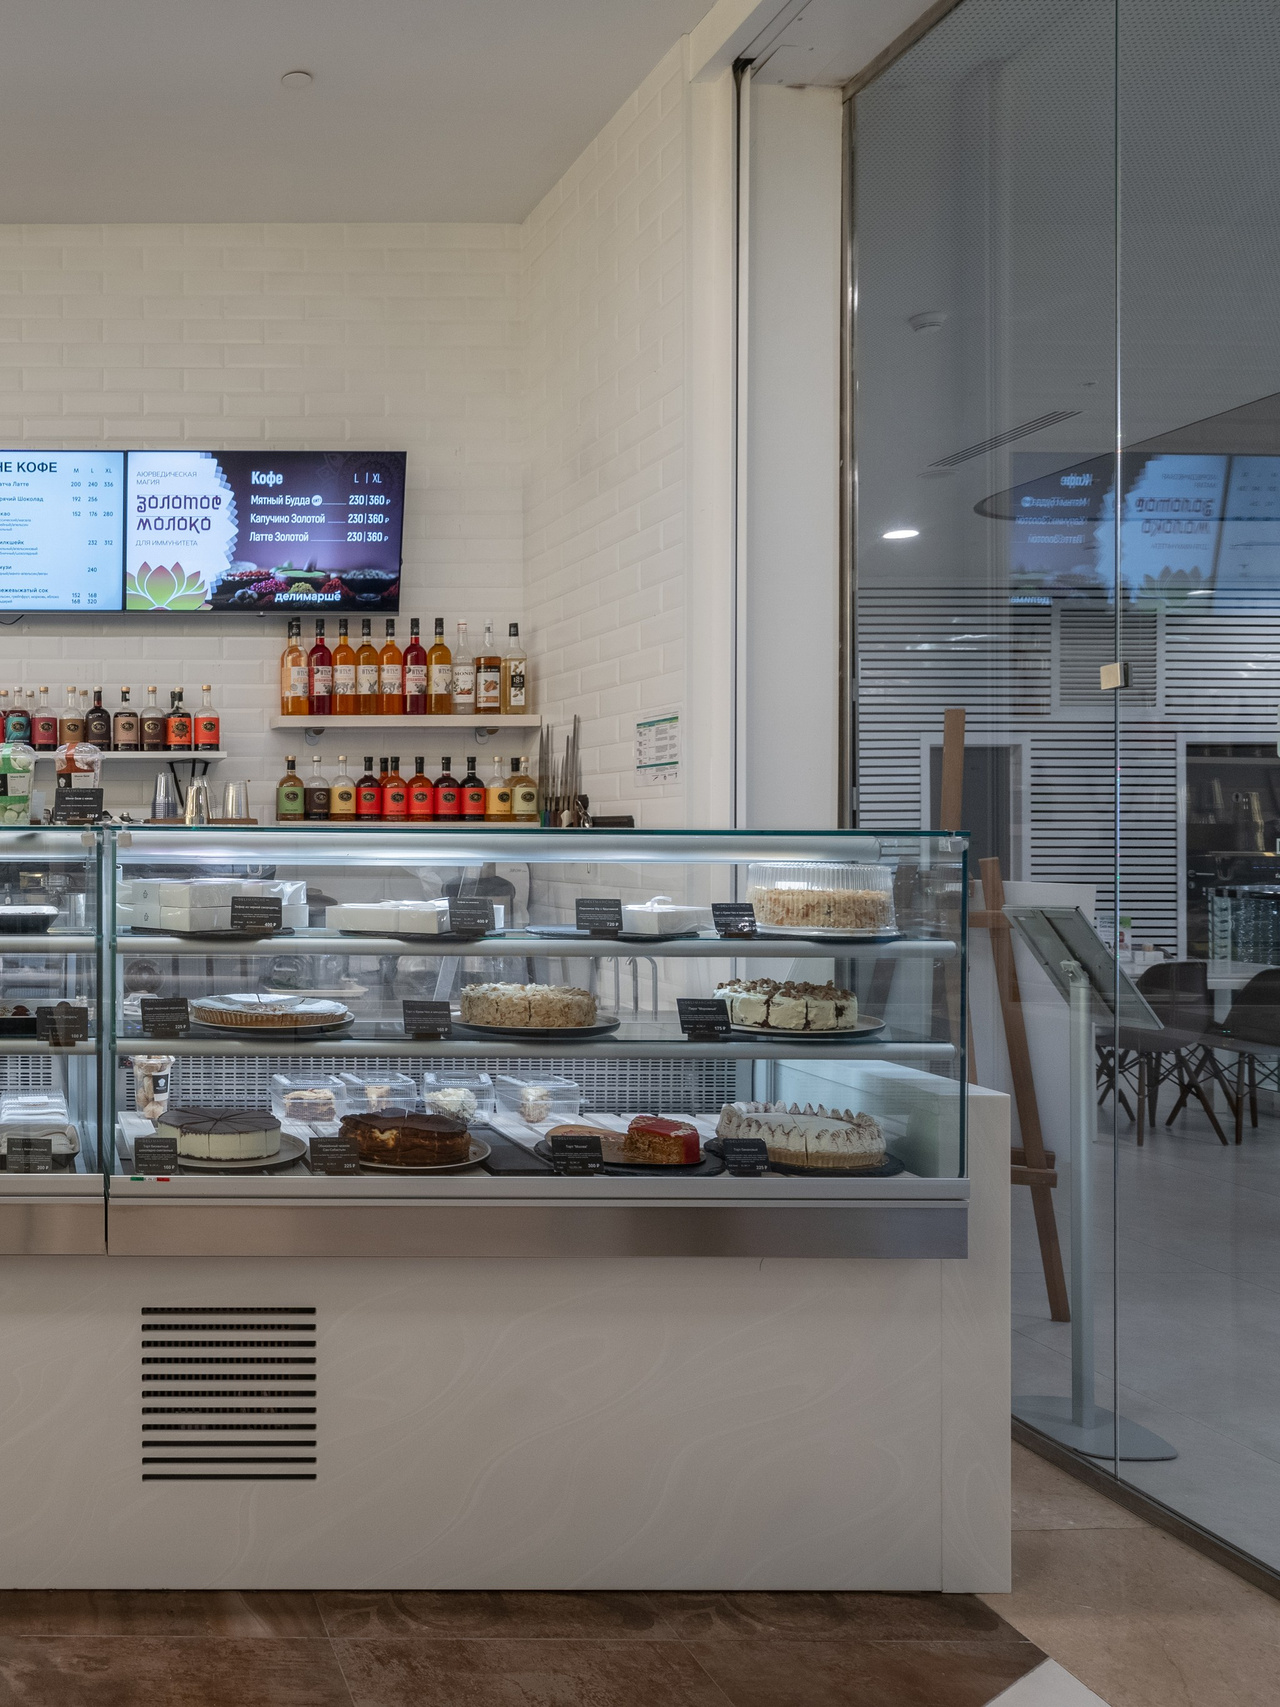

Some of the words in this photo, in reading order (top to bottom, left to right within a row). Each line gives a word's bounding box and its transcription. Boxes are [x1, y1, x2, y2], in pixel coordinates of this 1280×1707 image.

[17, 462, 58, 472] КОФЕ
[251, 471, 283, 487] Кофе
[354, 473, 359, 483] L
[372, 473, 382, 483] XL
[251, 494, 283, 505] Мятный
[285, 495, 310, 507] Будда
[250, 514, 290, 525] Капучино
[291, 513, 325, 523] Золотой
[250, 532, 272, 541] Латте
[275, 531, 309, 541] Золотой
